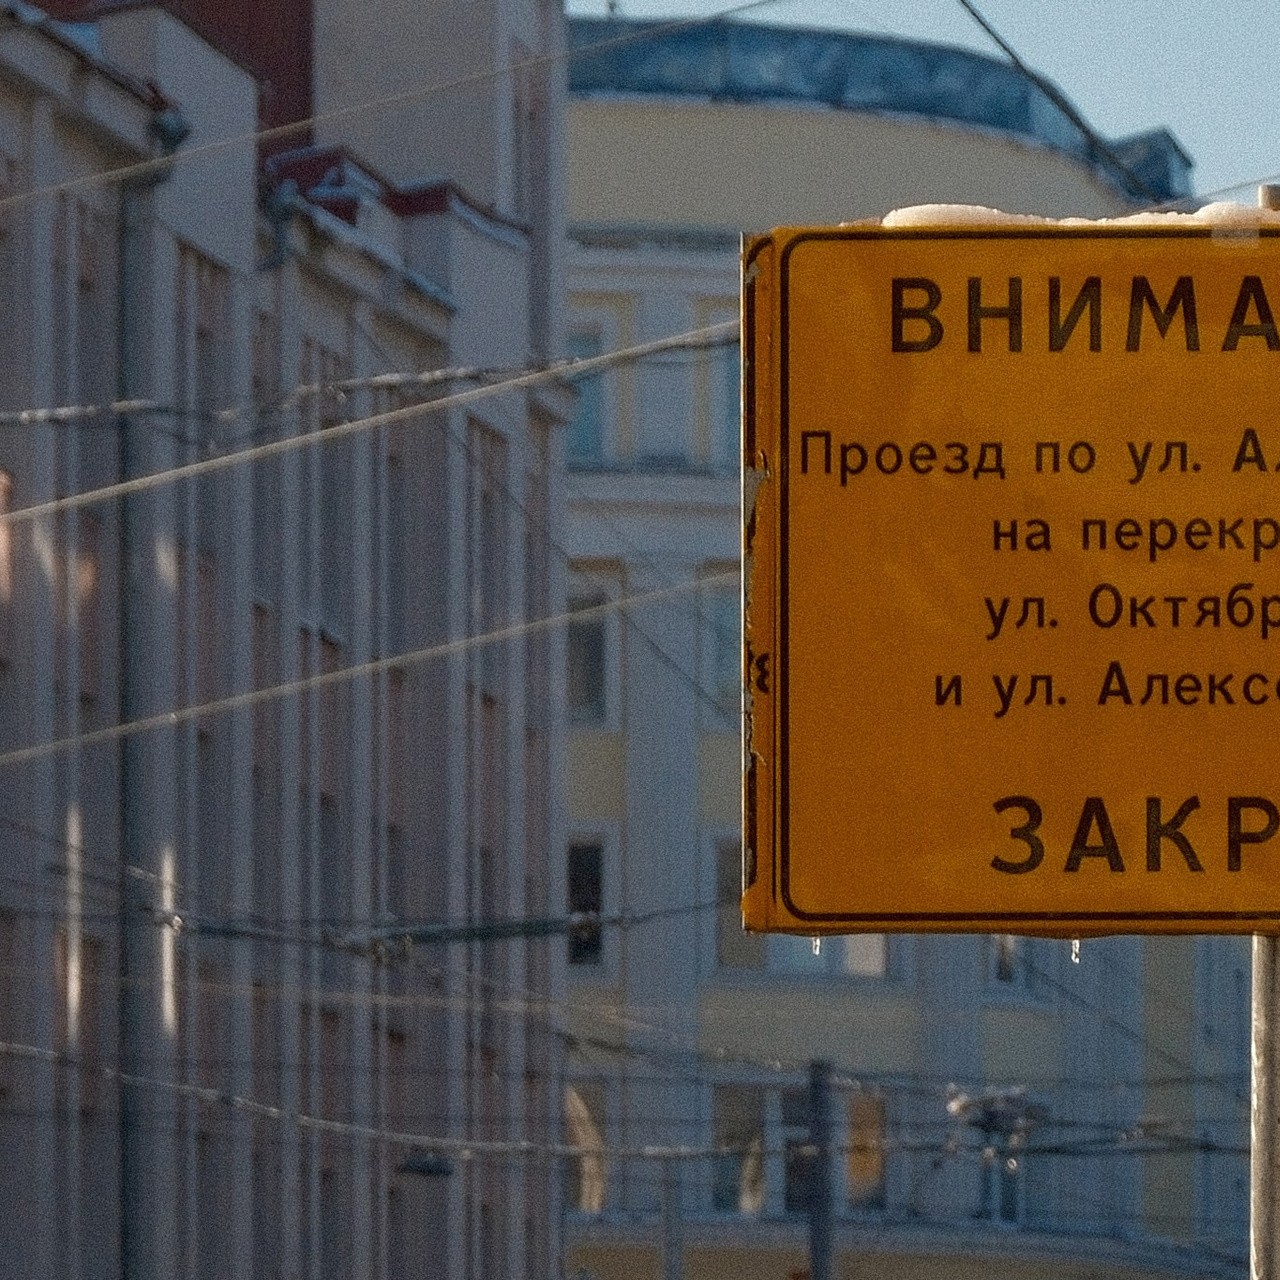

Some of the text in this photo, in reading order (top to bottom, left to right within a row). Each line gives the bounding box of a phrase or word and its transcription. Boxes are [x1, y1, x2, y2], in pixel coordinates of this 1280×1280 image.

[799, 429, 1007, 488] Проезд
[1035, 440, 1097, 475] по
[1127, 440, 1203, 485] ул.
[992, 518, 1053, 553] на
[983, 596, 1059, 642] ул.
[934, 674, 963, 707] и
[991, 673, 1068, 719] ул.
